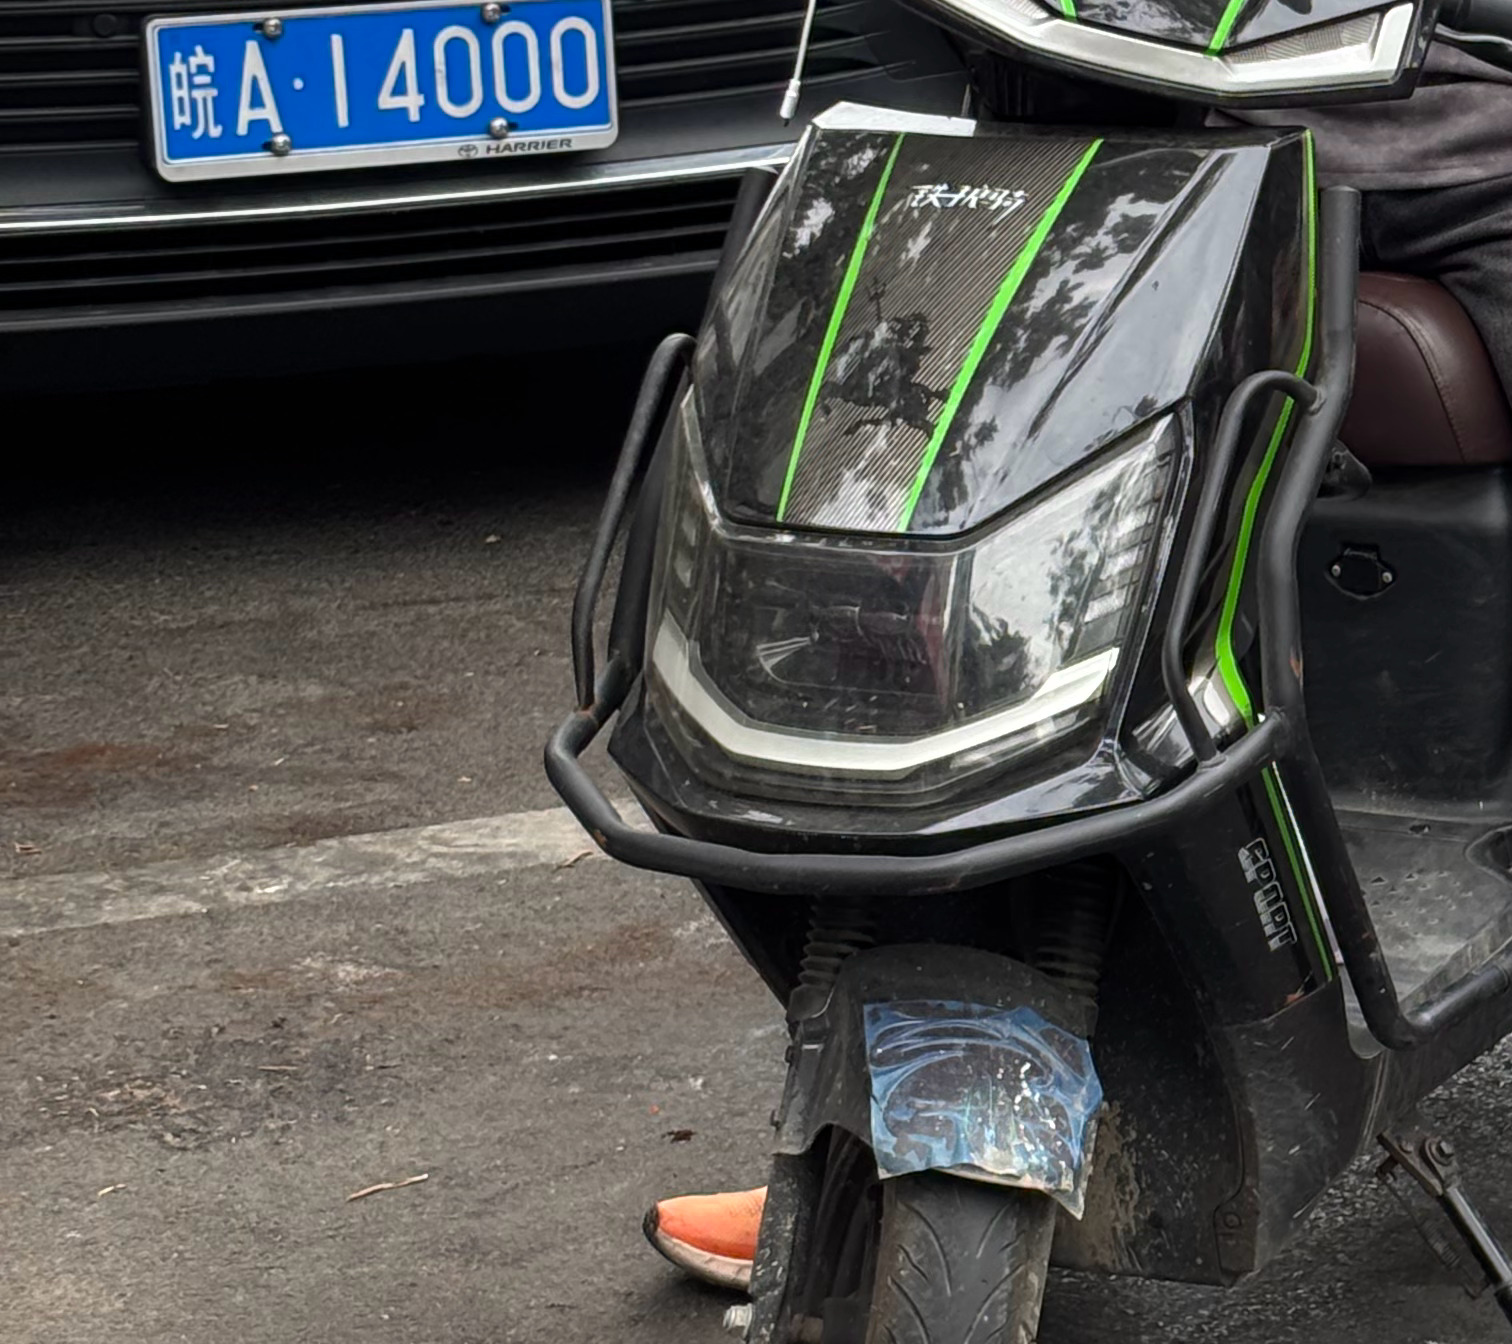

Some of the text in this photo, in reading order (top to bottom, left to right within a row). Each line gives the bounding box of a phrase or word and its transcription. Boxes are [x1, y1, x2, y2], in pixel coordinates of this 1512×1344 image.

[169, 16, 600, 140] 皖A·14000
[485, 138, 573, 155] HARRIER
[1238, 837, 1298, 952] SPORT
